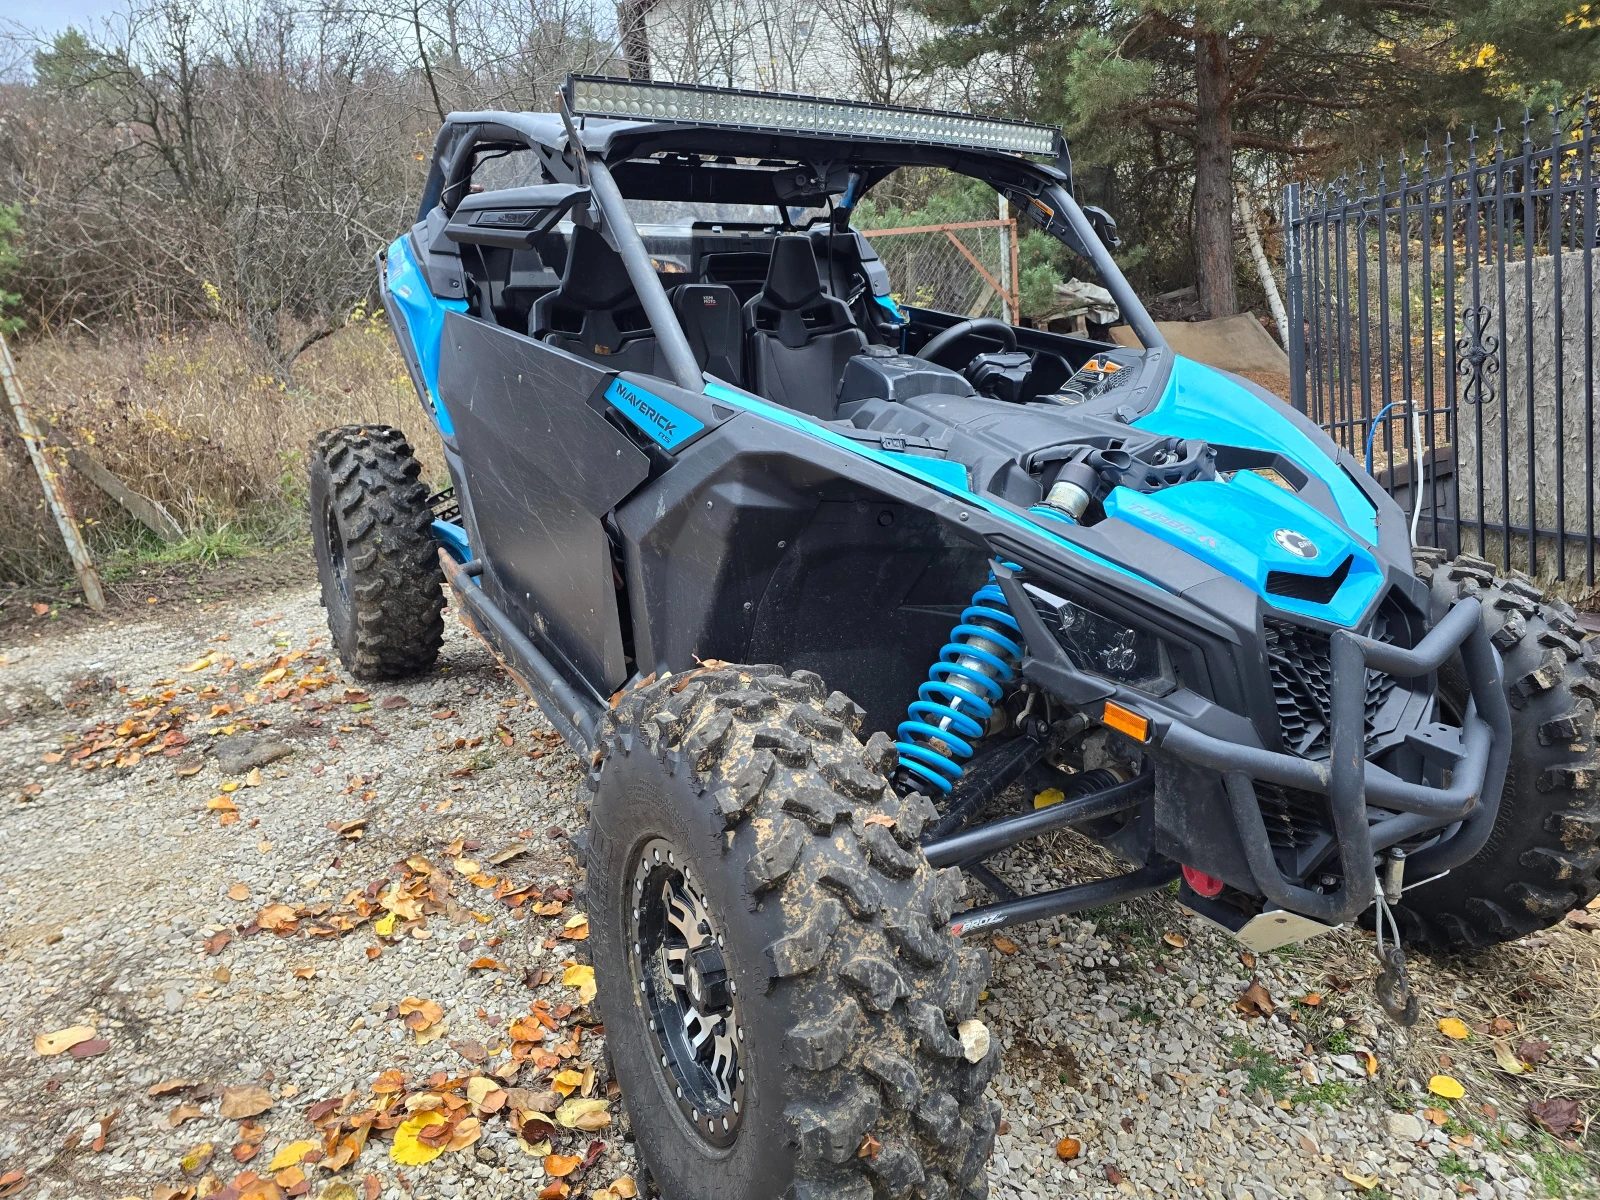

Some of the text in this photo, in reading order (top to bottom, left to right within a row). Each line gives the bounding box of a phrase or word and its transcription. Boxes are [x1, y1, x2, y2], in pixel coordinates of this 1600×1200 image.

[616, 382, 677, 436] MAVERICK
[1128, 503, 1196, 535] TURBO
[1297, 539, 1313, 548] BRP
